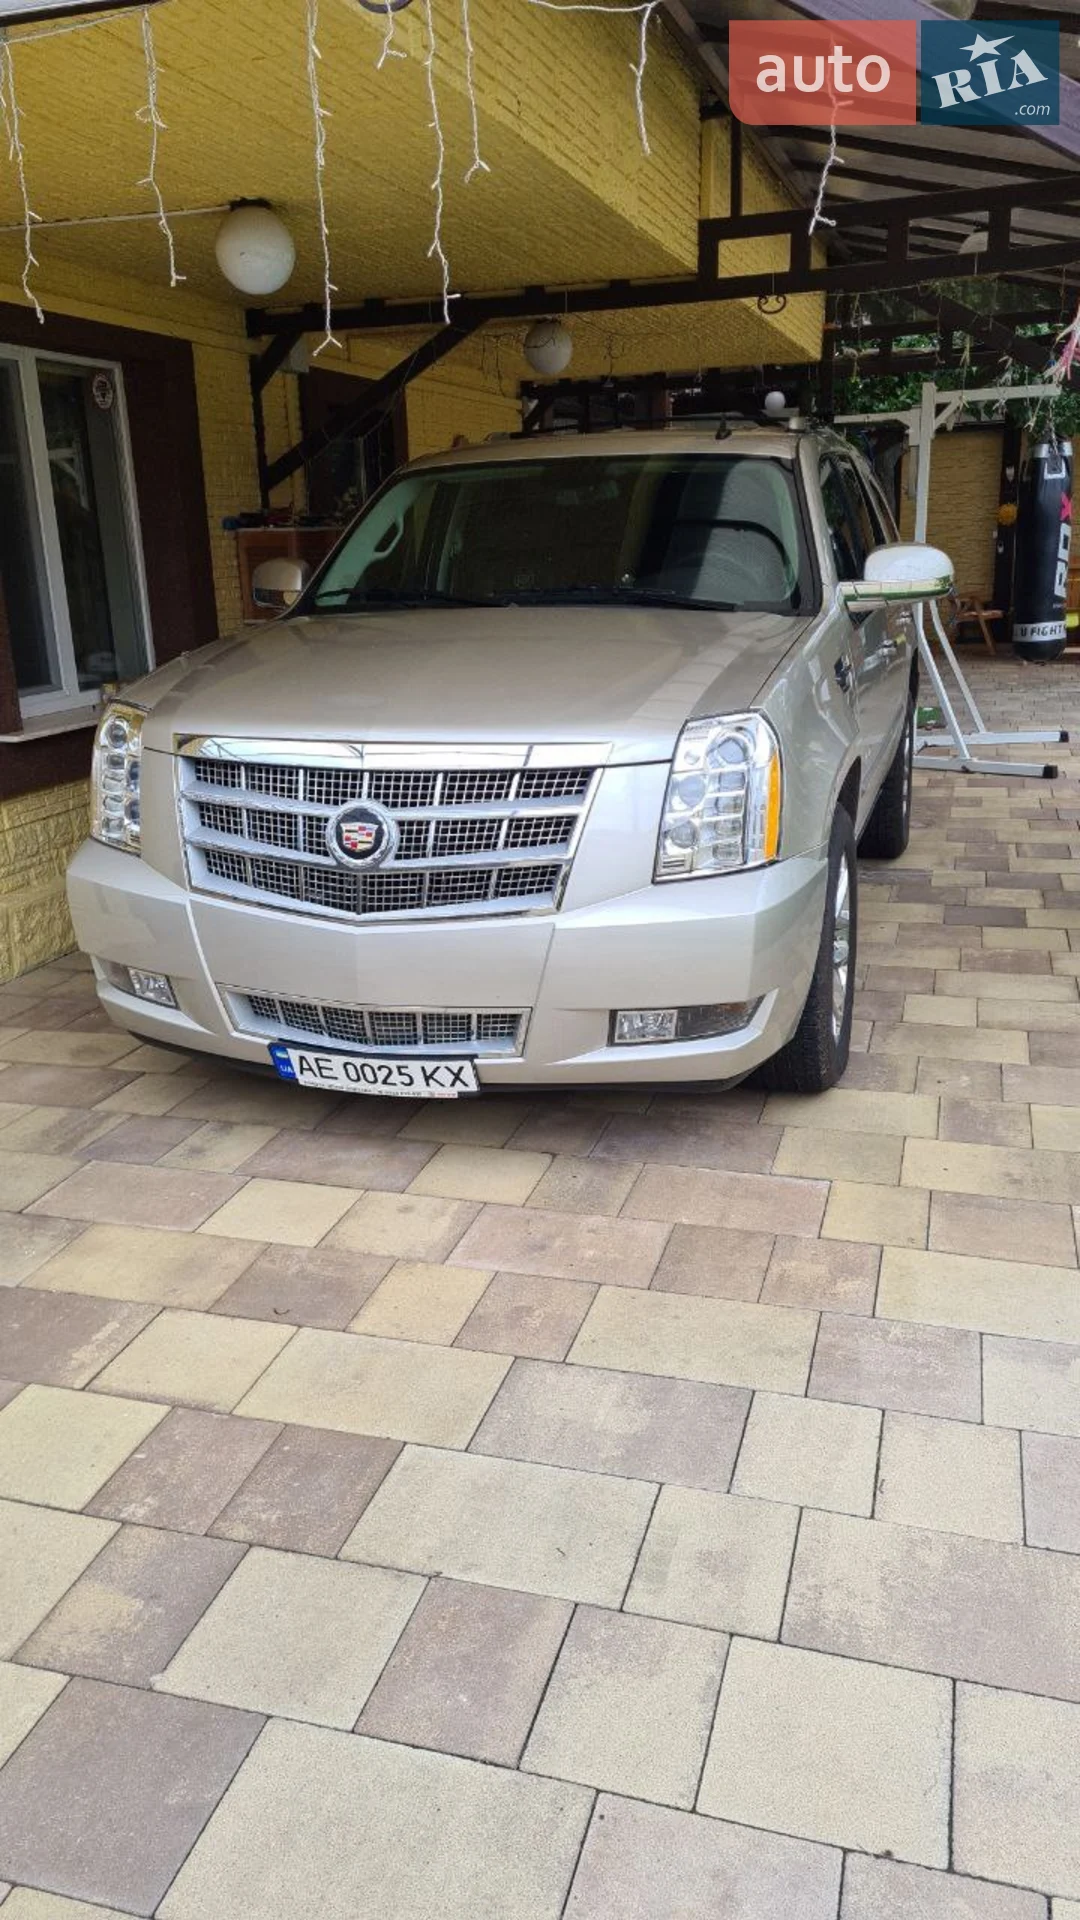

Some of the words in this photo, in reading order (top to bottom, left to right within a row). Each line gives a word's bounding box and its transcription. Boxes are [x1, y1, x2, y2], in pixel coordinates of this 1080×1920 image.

[280, 1064, 294, 1073] UA
[299, 1055, 338, 1080] AE
[343, 1061, 414, 1087] 0025
[421, 1066, 469, 1087] KX
